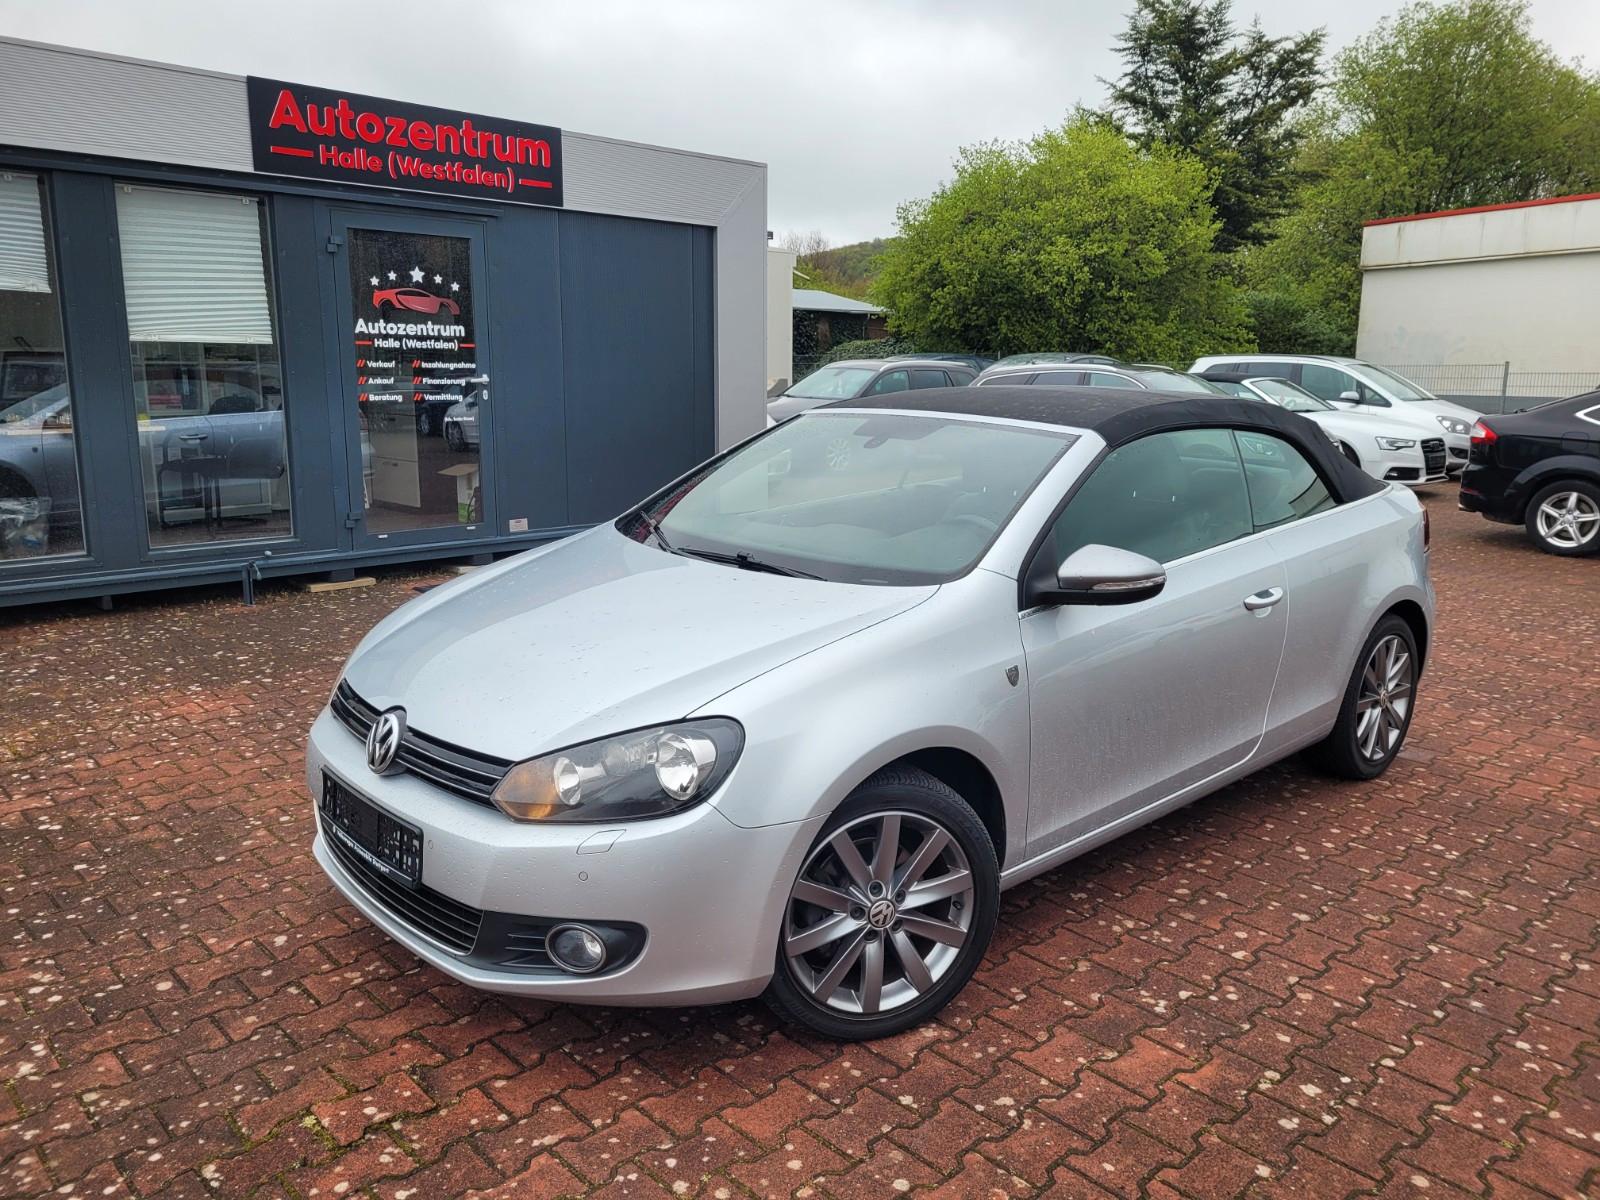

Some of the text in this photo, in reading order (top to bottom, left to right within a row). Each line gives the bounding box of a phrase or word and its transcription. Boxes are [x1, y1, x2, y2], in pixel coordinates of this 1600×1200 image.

[268, 89, 551, 168] Autozentrum
[319, 144, 515, 193] Halle (Westfalen)
[355, 318, 465, 337] Autozentrum
[374, 338, 458, 351] Halle (Westfalen)
[367, 360, 395, 368] Verkauf
[421, 361, 476, 370] Inzahlungnahme
[422, 377, 465, 386] Finanzierung
[369, 394, 403, 402] Beratung
[423, 393, 463, 402] Vermittlung
